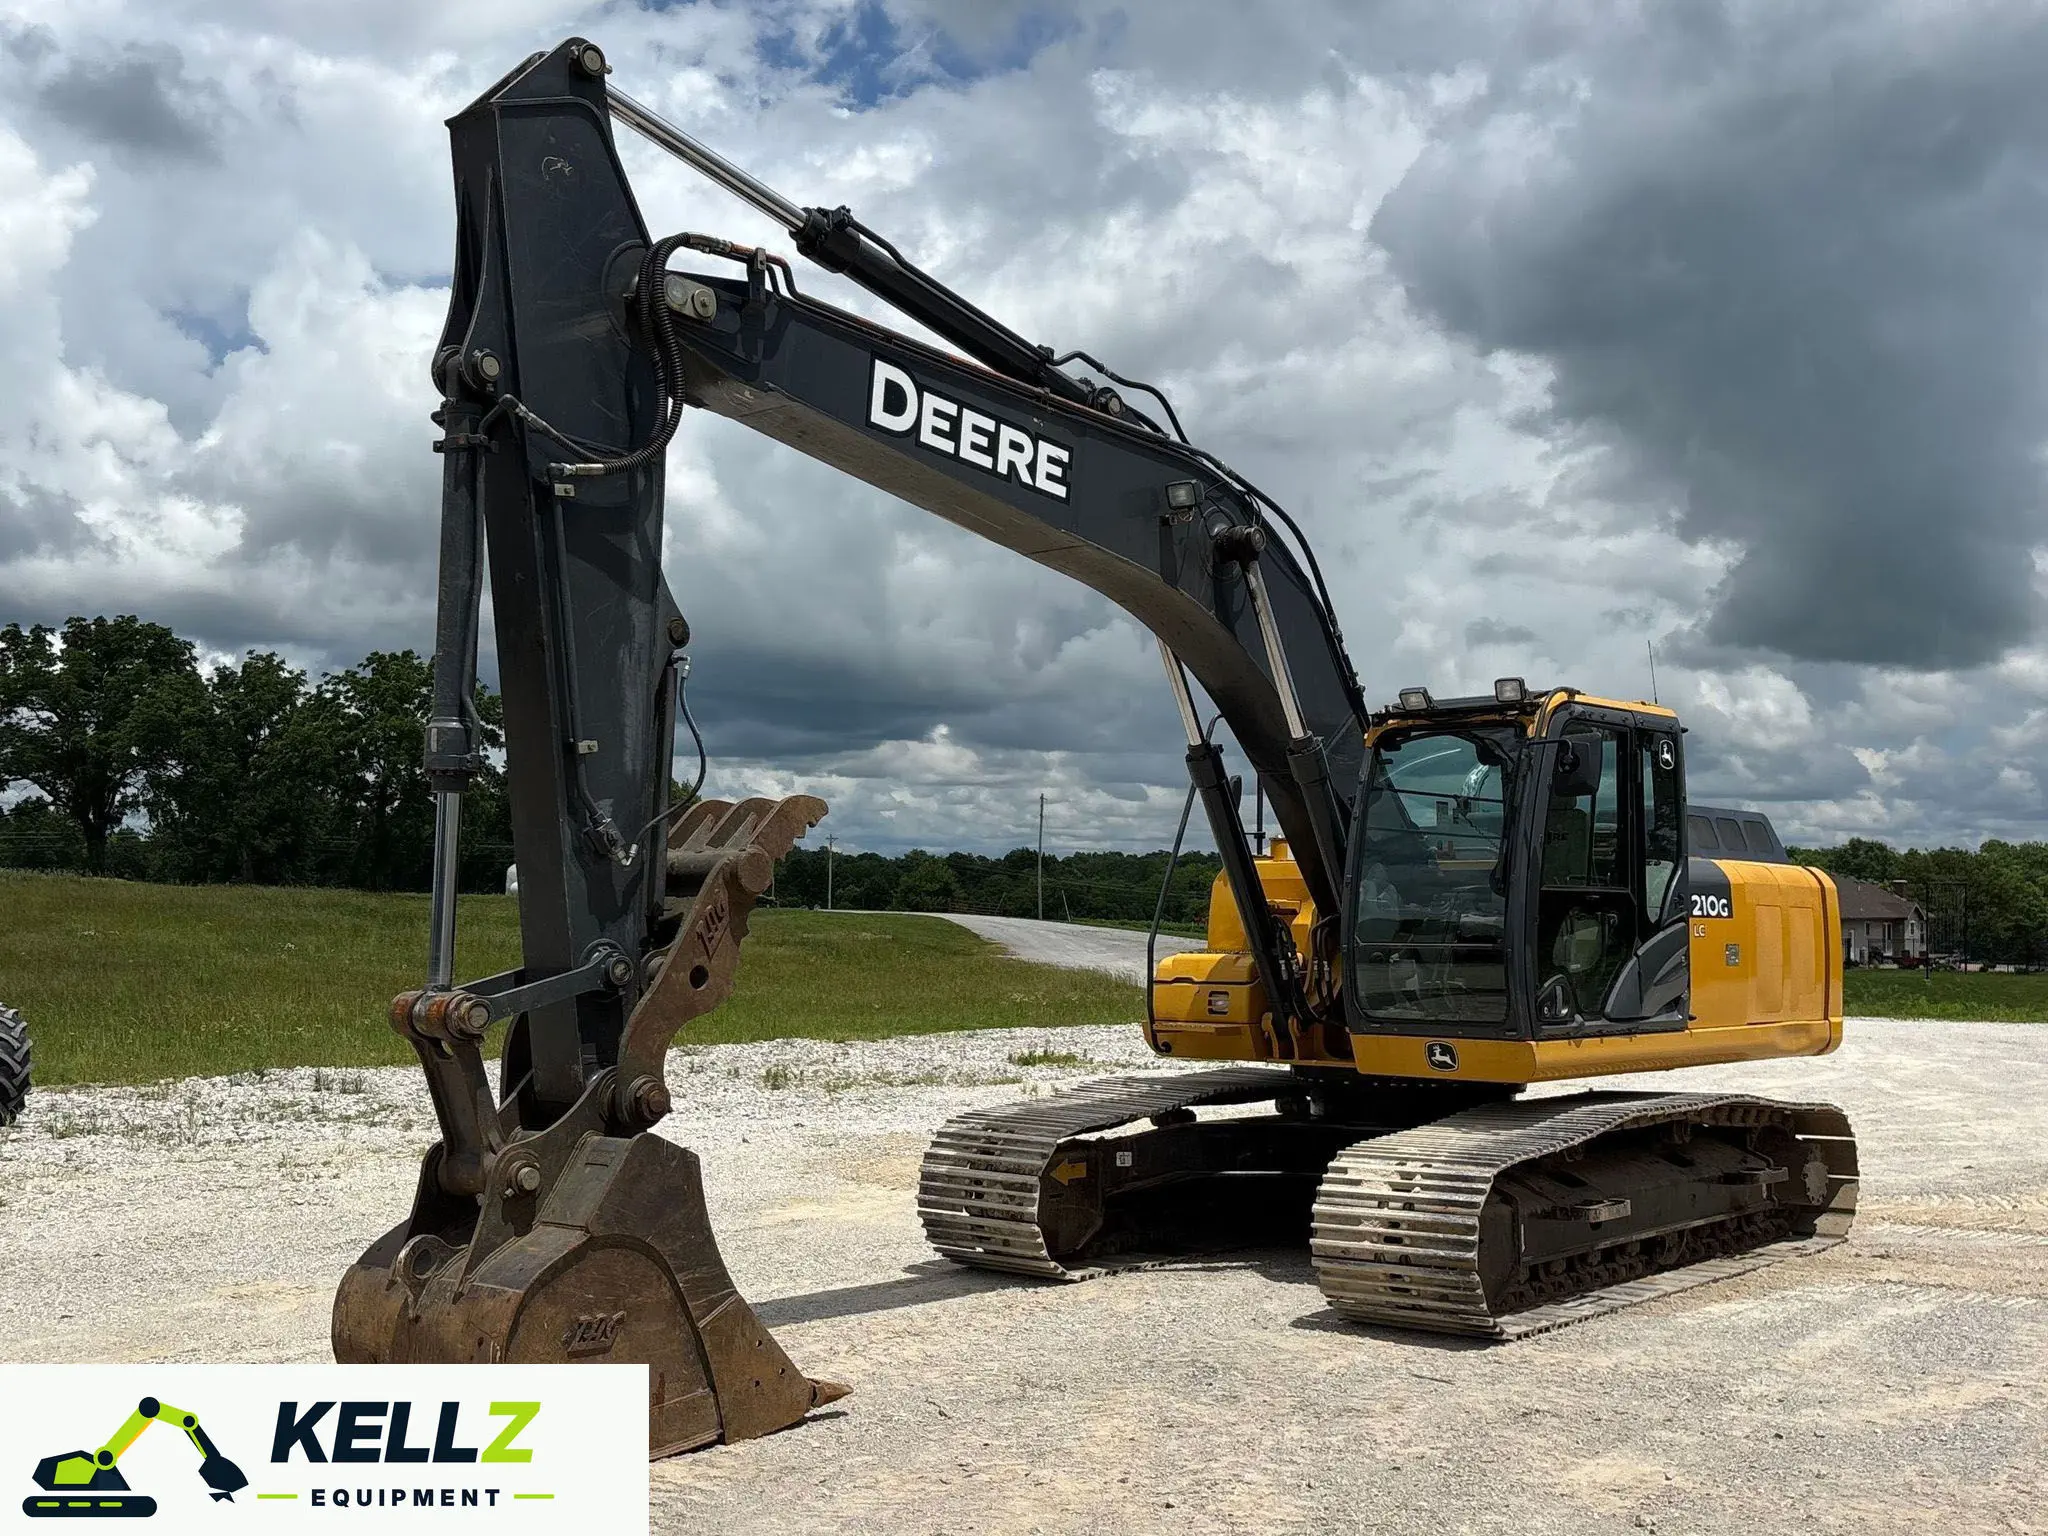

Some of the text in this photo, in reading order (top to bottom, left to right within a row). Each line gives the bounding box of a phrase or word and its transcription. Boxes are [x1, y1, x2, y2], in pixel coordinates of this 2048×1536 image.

[870, 358, 1070, 498] DEERE
[1691, 894, 1729, 917] 210G
[1693, 924, 1706, 937] LC
